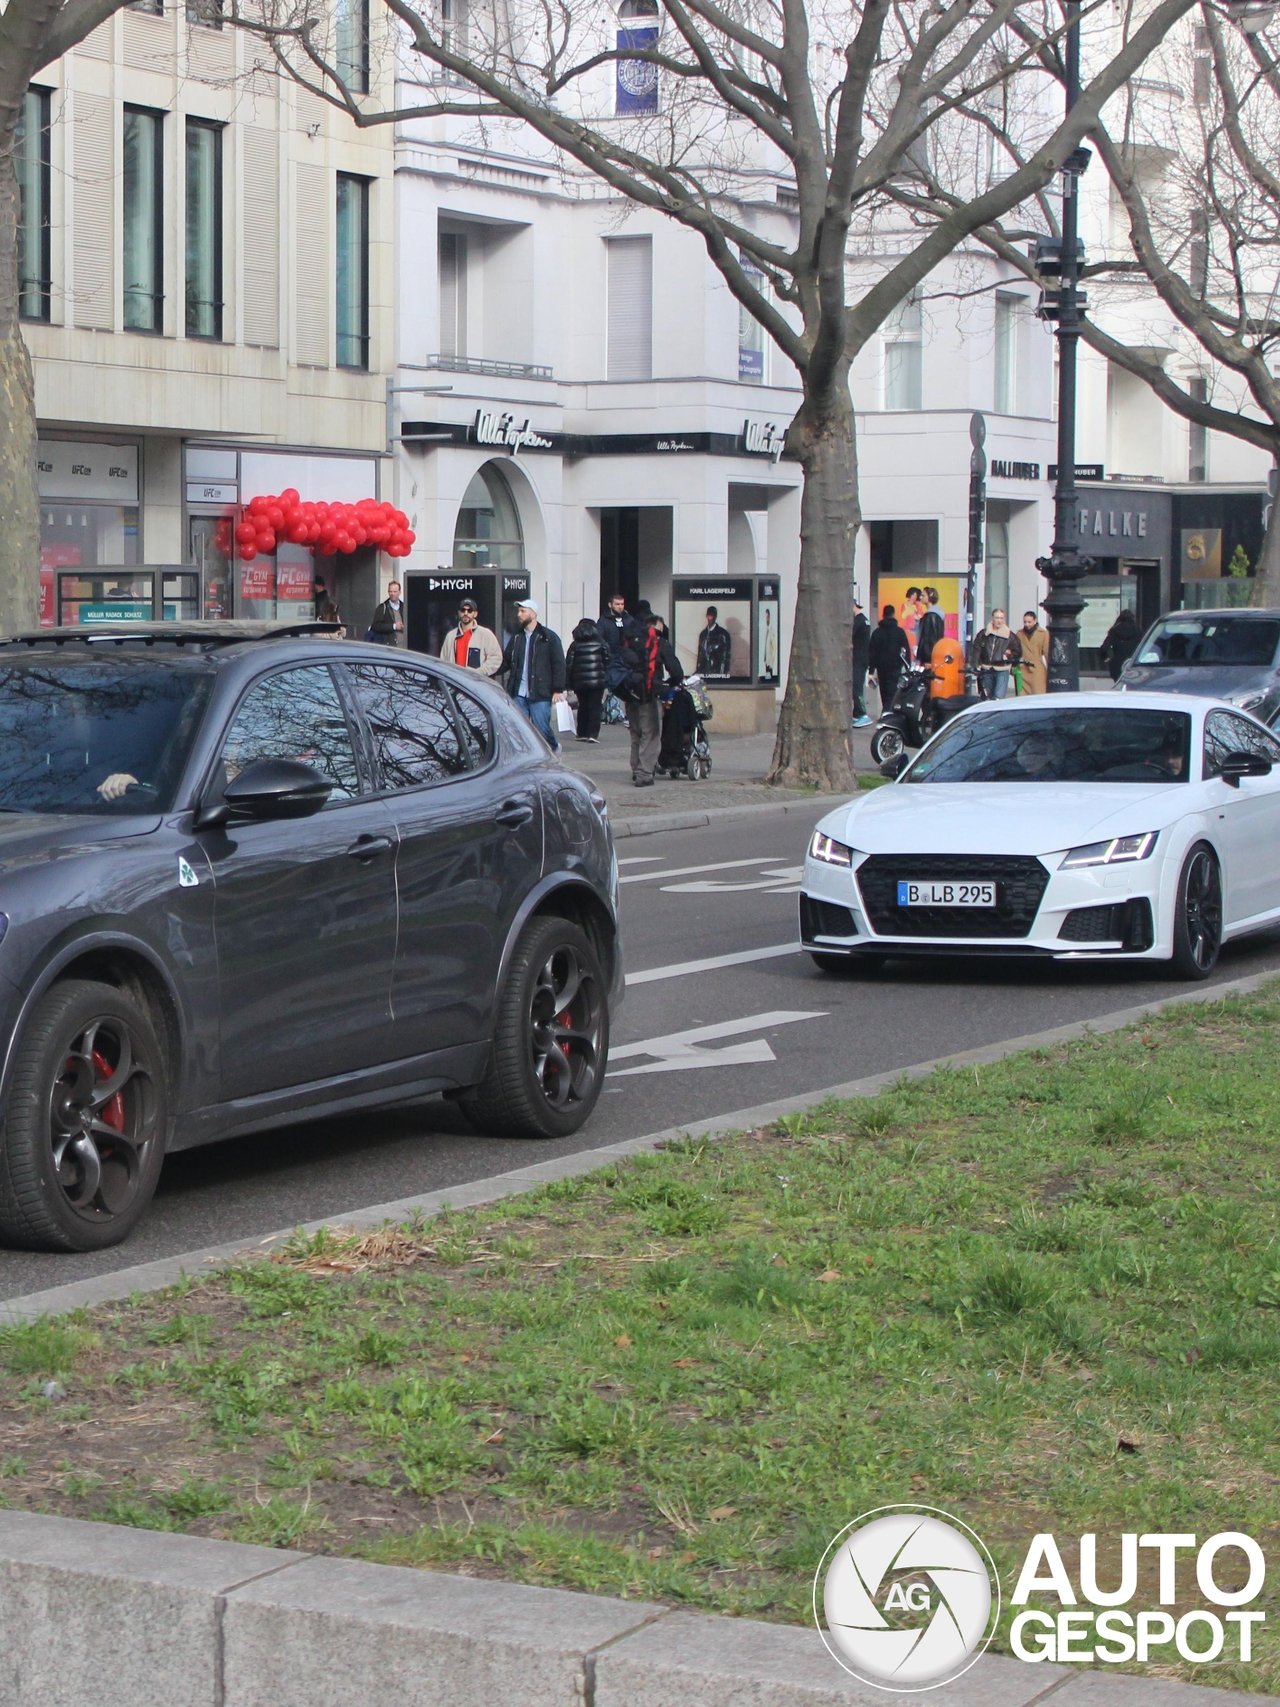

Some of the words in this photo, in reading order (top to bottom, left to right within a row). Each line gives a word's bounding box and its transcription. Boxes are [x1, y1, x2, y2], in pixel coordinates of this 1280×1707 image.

[477, 409, 504, 445] Ulla
[502, 412, 552, 456] Popken
[746, 419, 769, 452] Ulla
[657, 441, 669, 450] Ulla
[670, 441, 694, 451] Popken
[1080, 509, 1147, 537] FALKE
[253, 571, 268, 581] GYM
[296, 571, 310, 581] GYM
[441, 579, 473, 590] HYGH
[510, 579, 527, 590] HYGH
[909, 885, 919, 902] B
[931, 885, 954, 903] LB
[959, 886, 992, 903] 295
